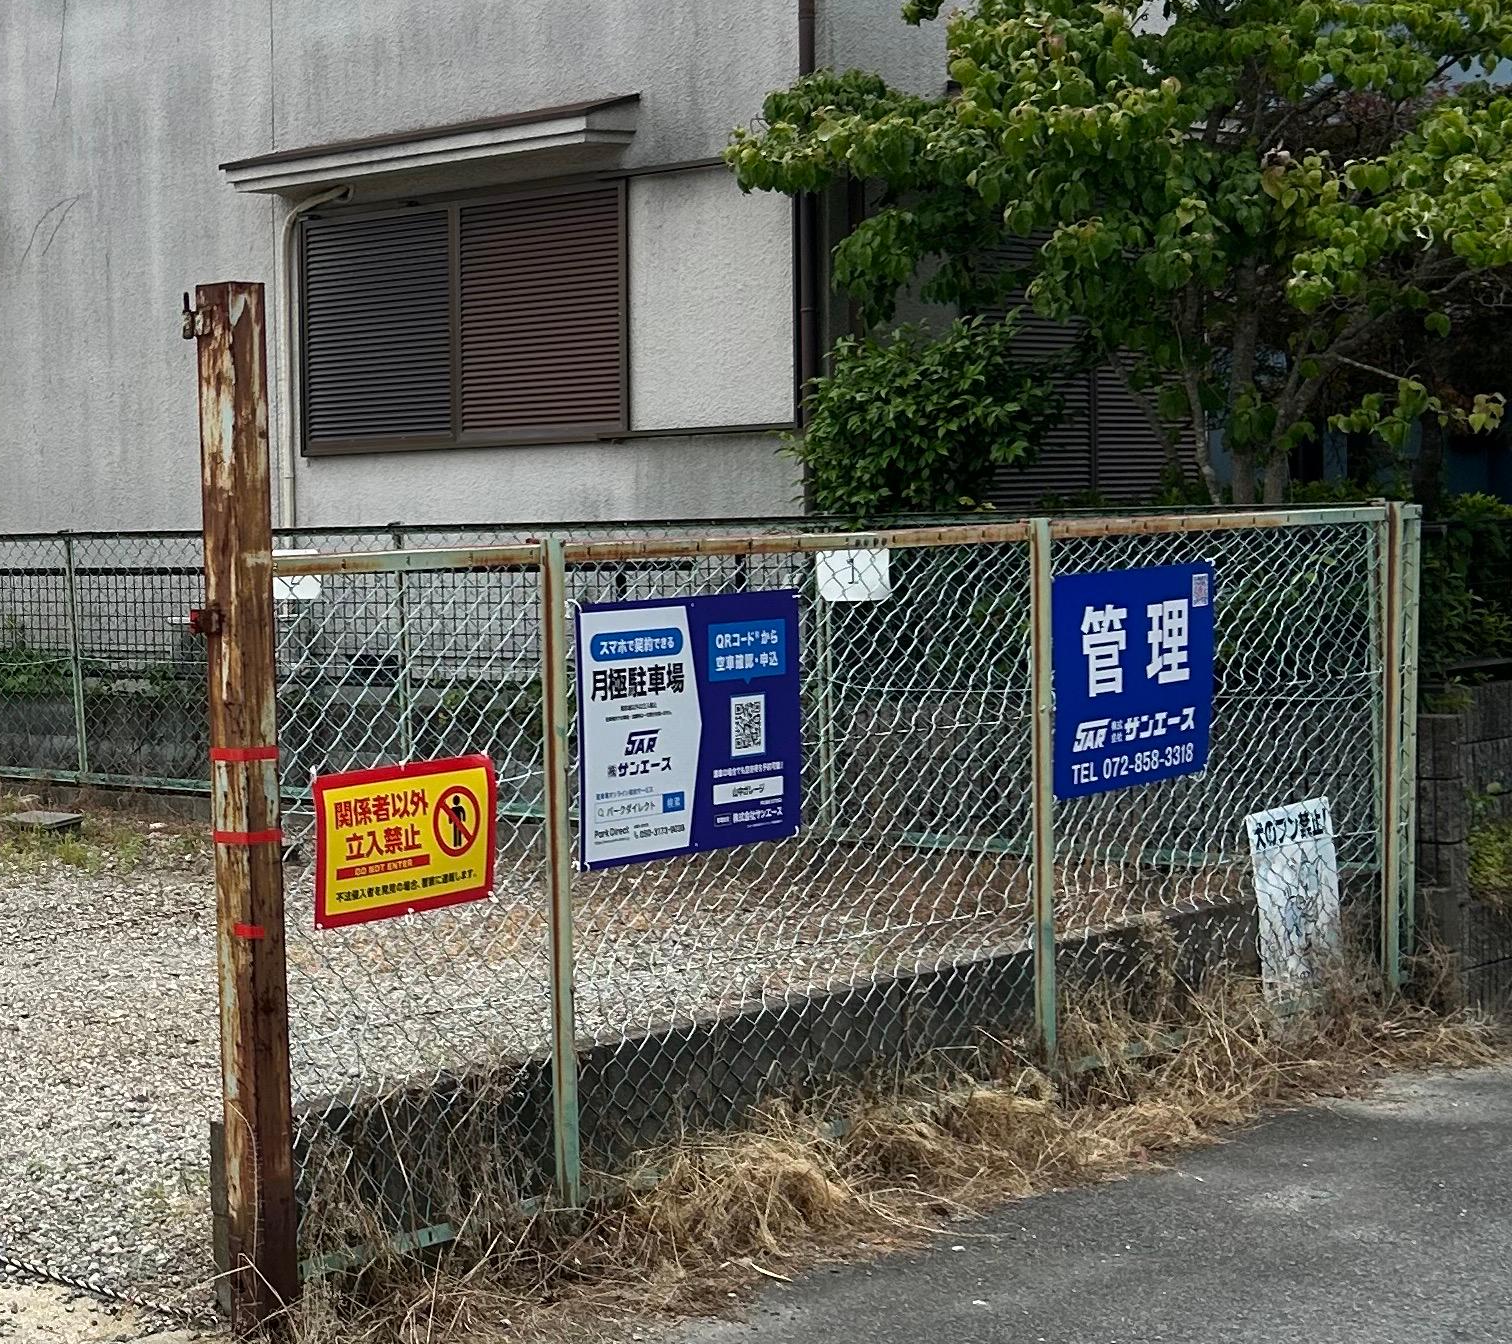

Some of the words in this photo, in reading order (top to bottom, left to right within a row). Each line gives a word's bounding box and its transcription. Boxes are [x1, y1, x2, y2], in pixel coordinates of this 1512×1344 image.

[846, 558, 859, 584] 1
[599, 636, 675, 655] スマホで契約できる
[1081, 599, 1190, 697] 管理
[591, 662, 685, 702] 月極駐車場
[1124, 706, 1196, 741] サンエース
[1071, 762, 1098, 785] TEL
[1103, 742, 1194, 779] 072-858-3318
[335, 789, 429, 830] 関係者以外
[345, 824, 422, 861] 立入禁止
[355, 867, 367, 876] DO
[369, 863, 386, 873] NOT
[387, 859, 413, 871] ENTER
